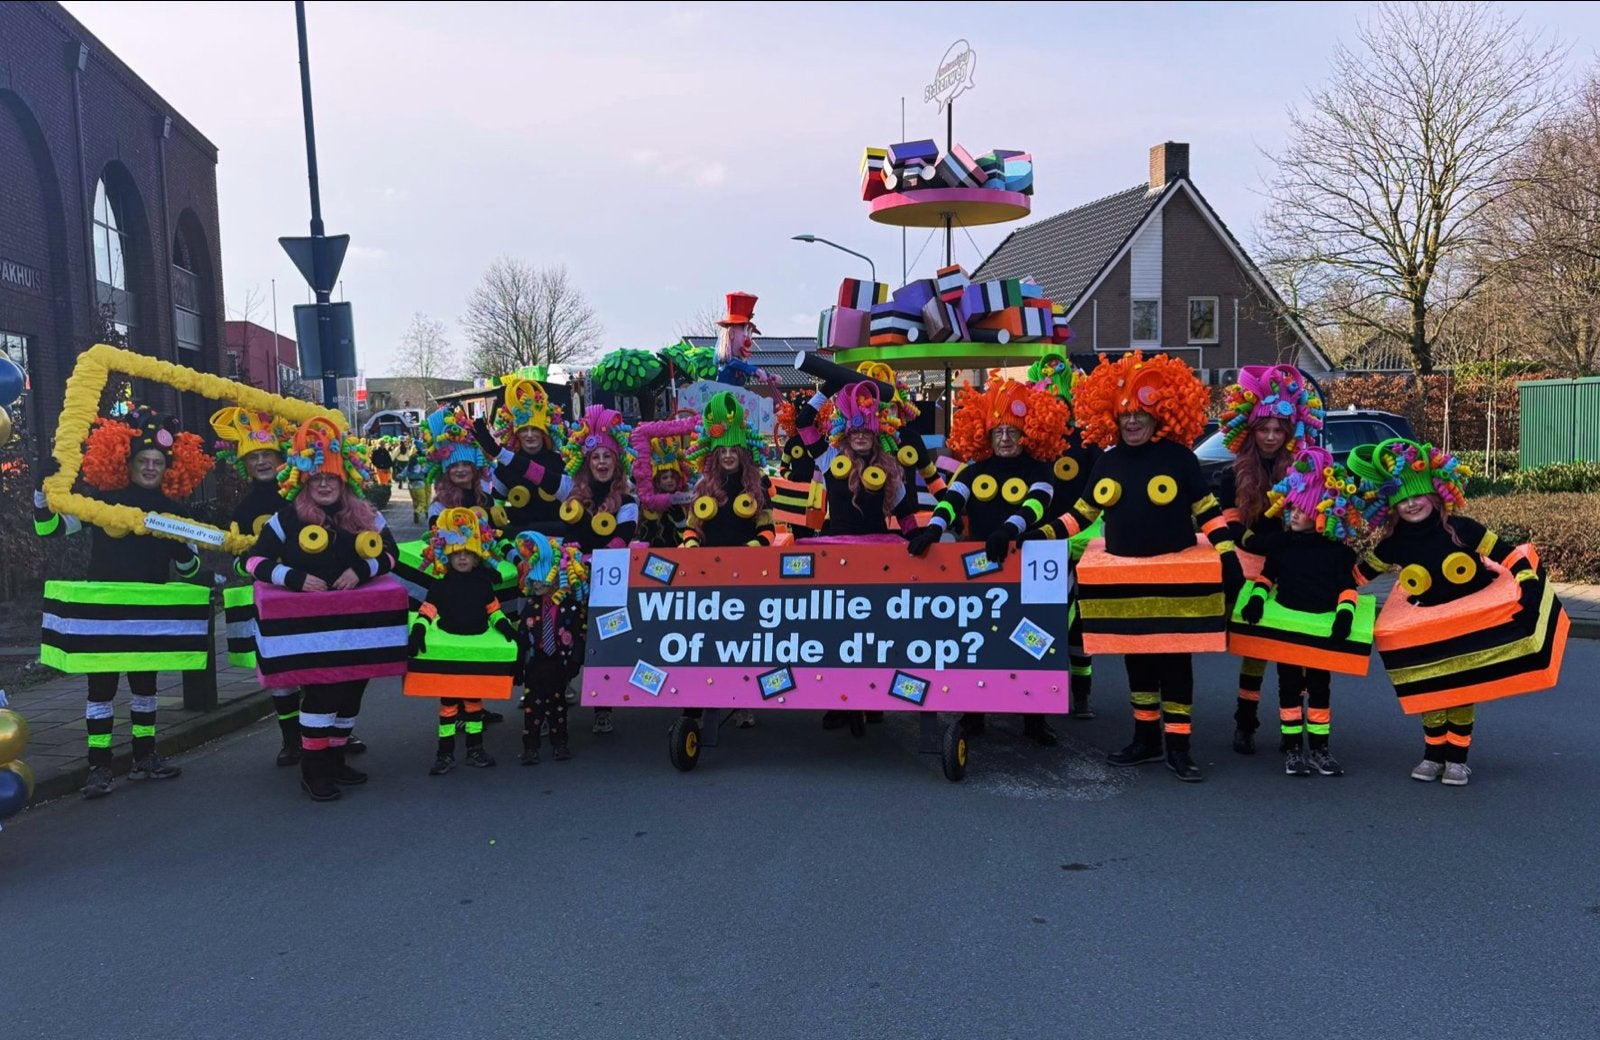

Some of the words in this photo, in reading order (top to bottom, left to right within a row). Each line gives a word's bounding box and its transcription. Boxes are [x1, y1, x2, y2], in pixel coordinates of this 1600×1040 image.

[0, 262, 41, 292] AKHUIS
[595, 566, 622, 586] 19
[1027, 559, 1059, 582] 19
[638, 590, 745, 621] Wilde
[759, 589, 872, 628] gullie
[886, 587, 1009, 627] drop?
[659, 632, 705, 663] Of
[715, 632, 824, 663] wilde
[839, 632, 895, 663] d'r
[906, 631, 985, 671] op?
